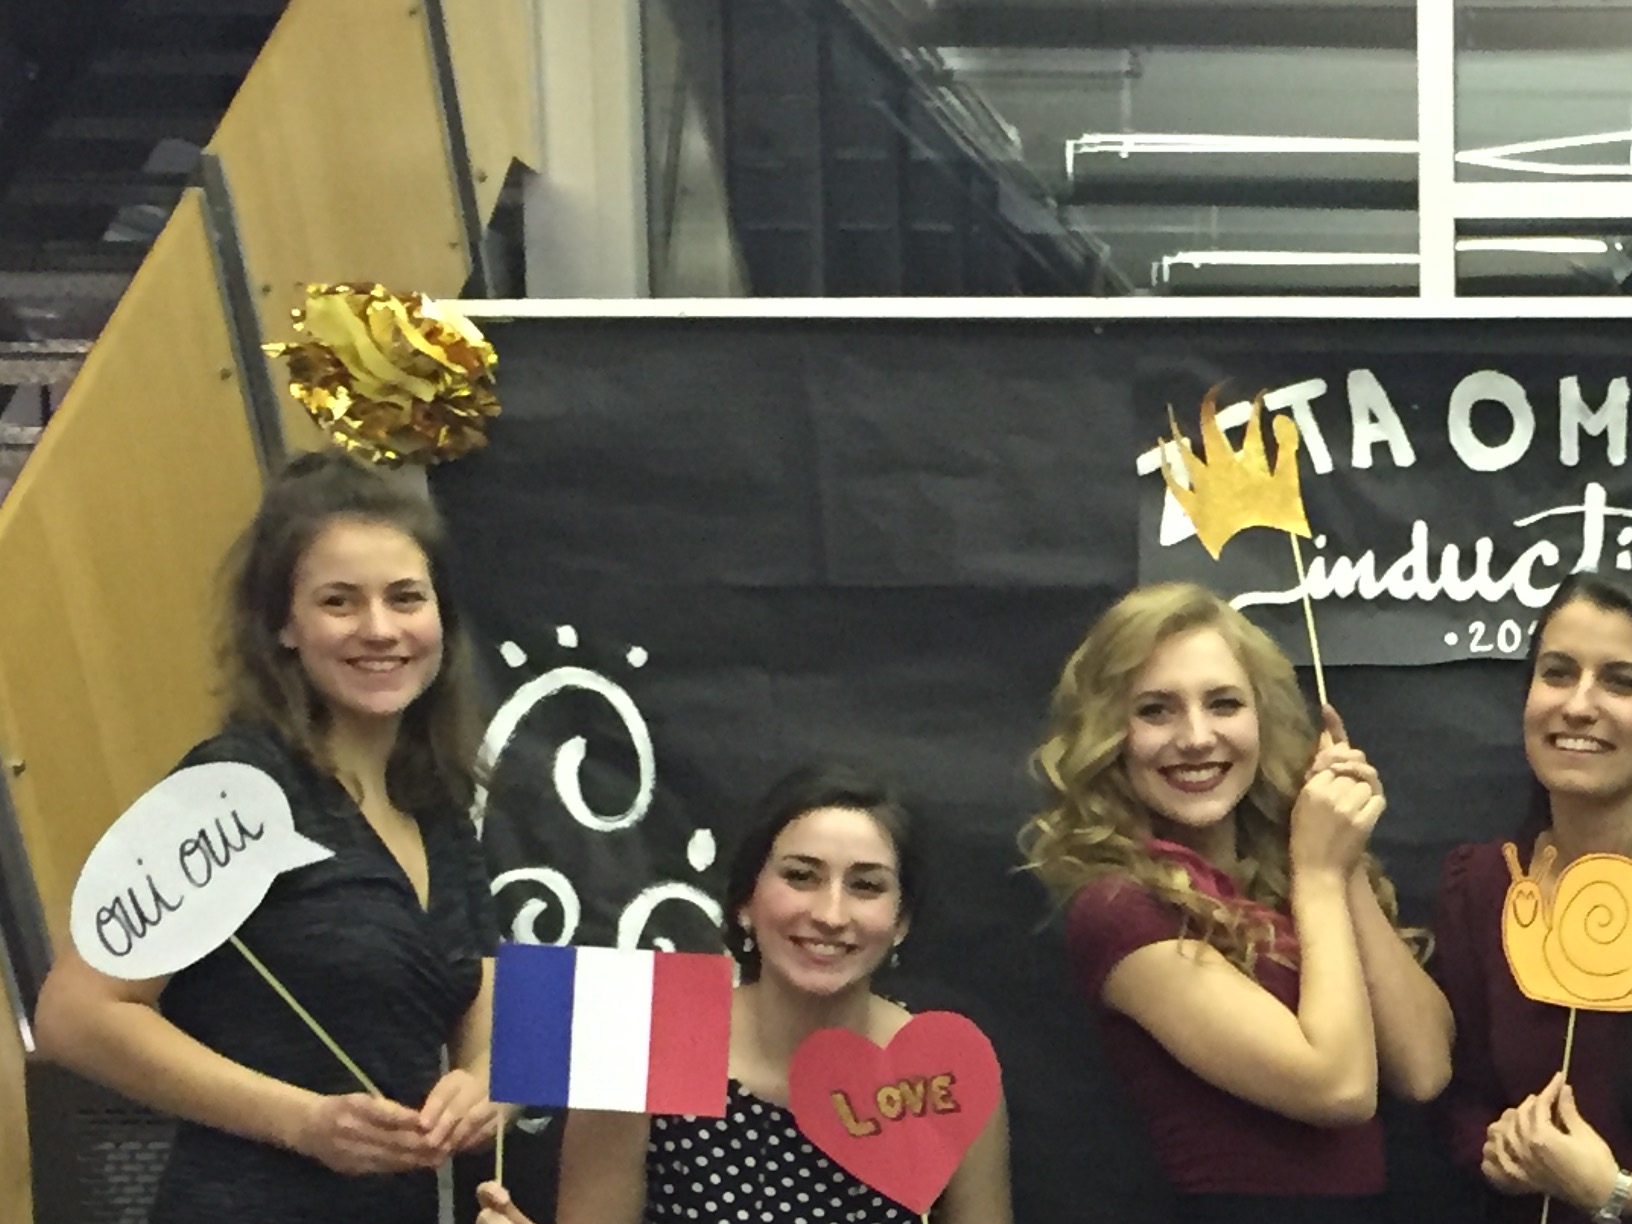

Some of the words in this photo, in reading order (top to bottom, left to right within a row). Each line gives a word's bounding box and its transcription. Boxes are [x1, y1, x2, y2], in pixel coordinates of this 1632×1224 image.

[96, 857, 185, 957] oui
[179, 790, 264, 888] oui
[829, 1071, 961, 1139] LOVE
